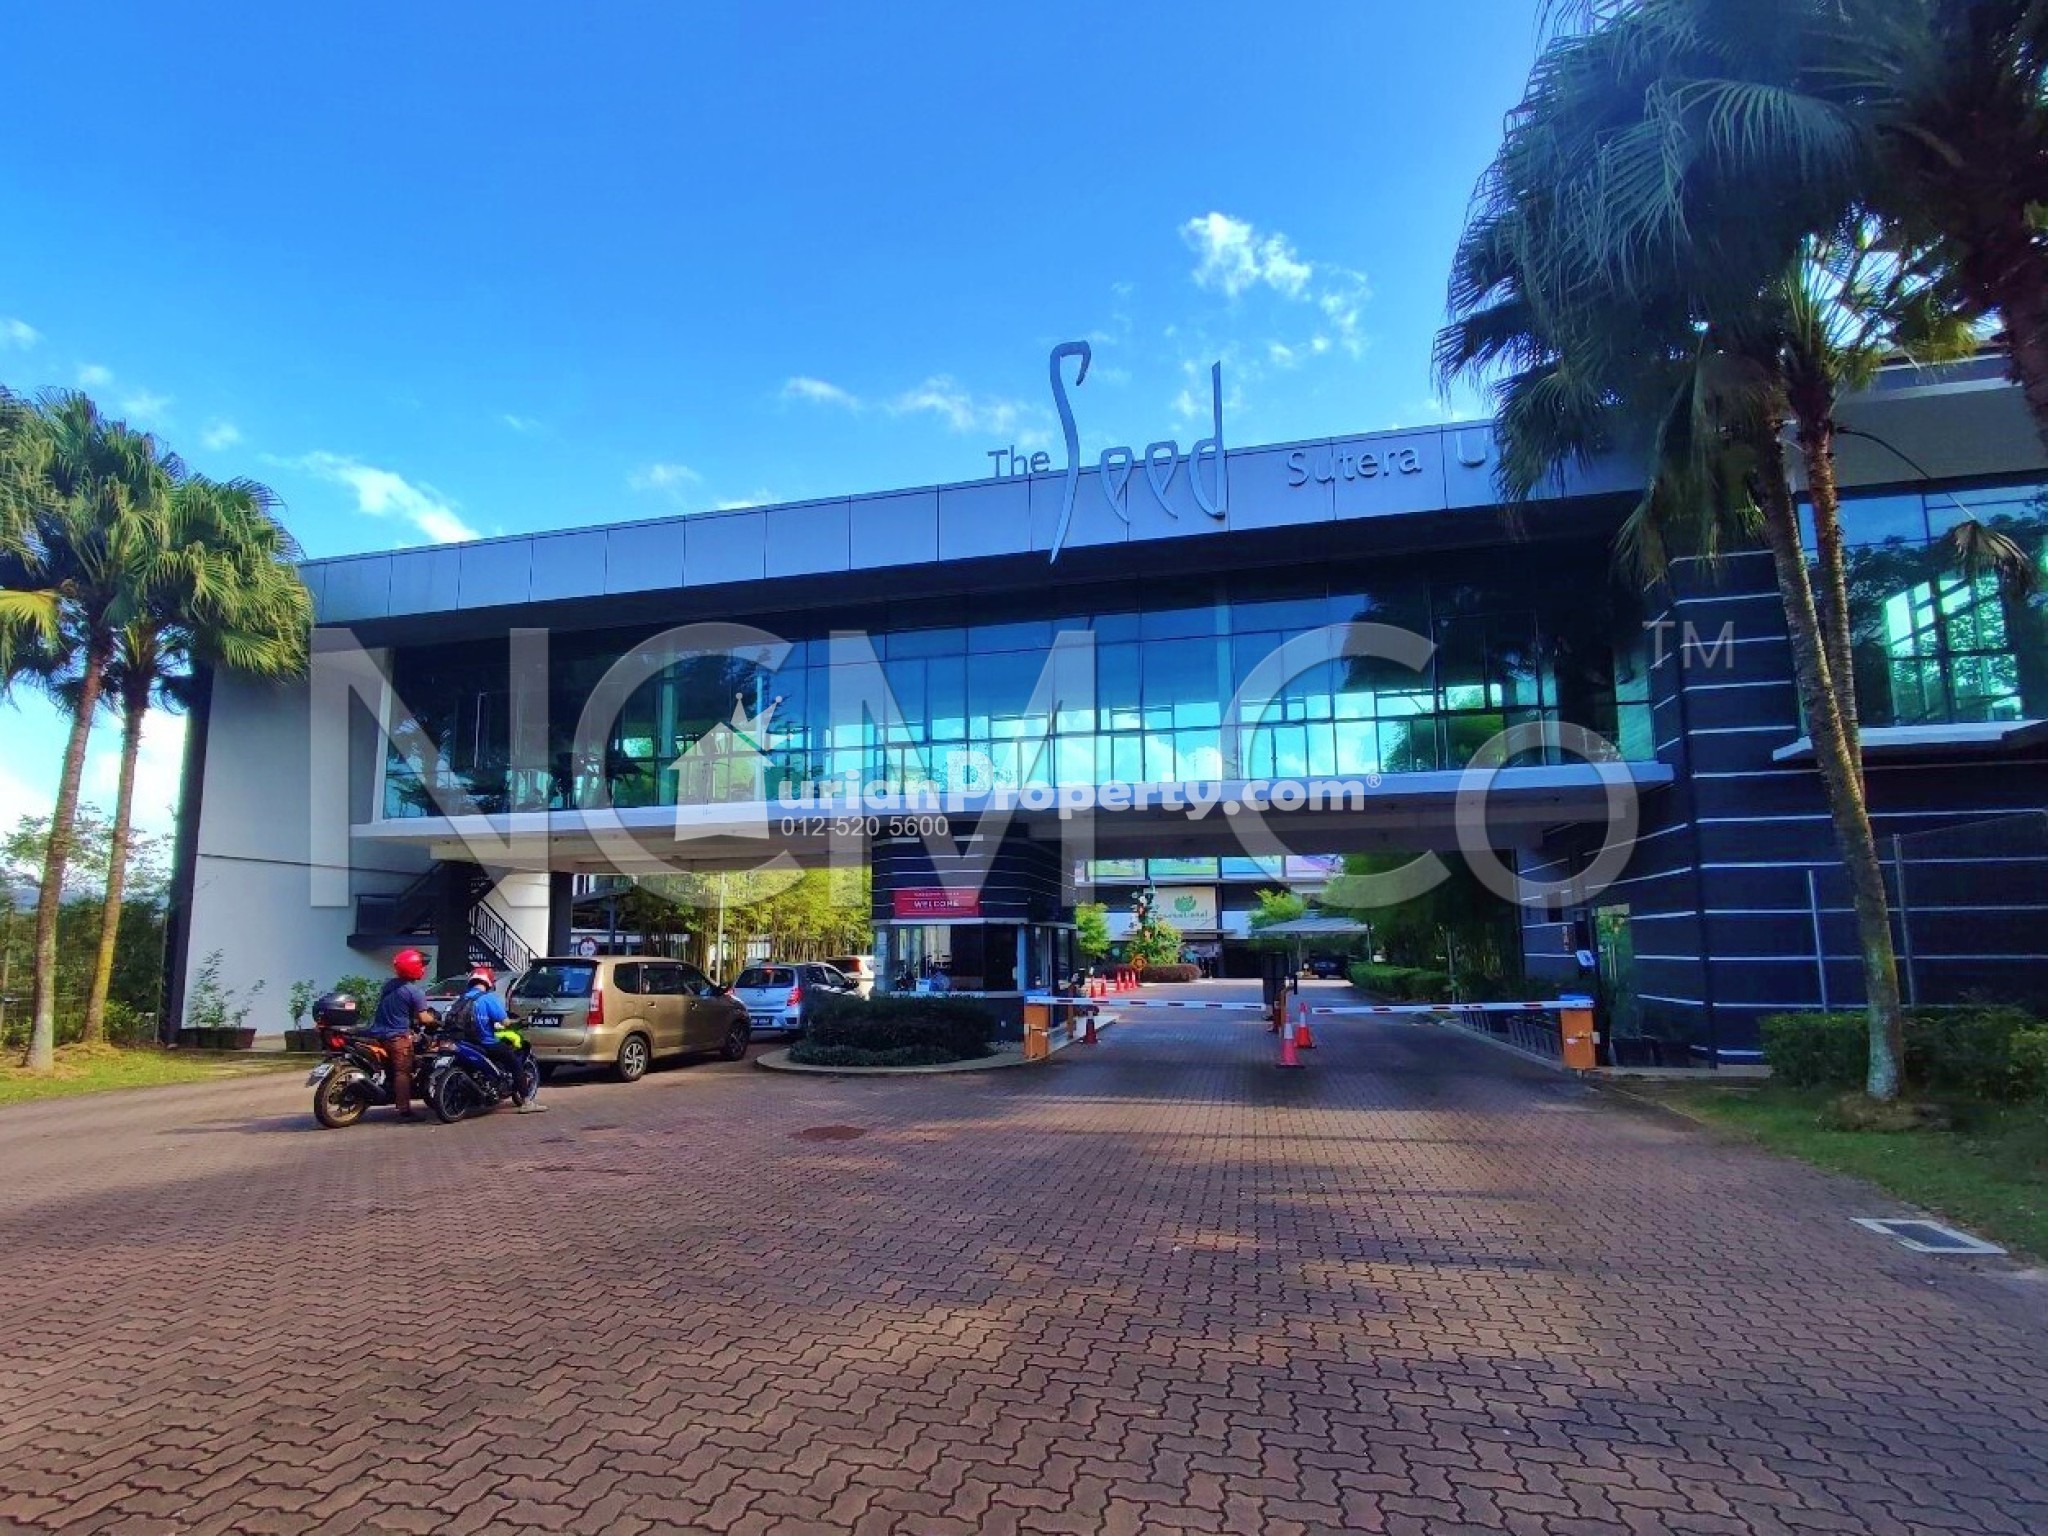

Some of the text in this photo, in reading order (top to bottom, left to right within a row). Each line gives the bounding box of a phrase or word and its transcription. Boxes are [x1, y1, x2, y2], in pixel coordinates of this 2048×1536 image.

[988, 340, 1226, 564] The Seed
[1288, 447, 1423, 486] Sutera
[913, 900, 960, 908] WELCOME
